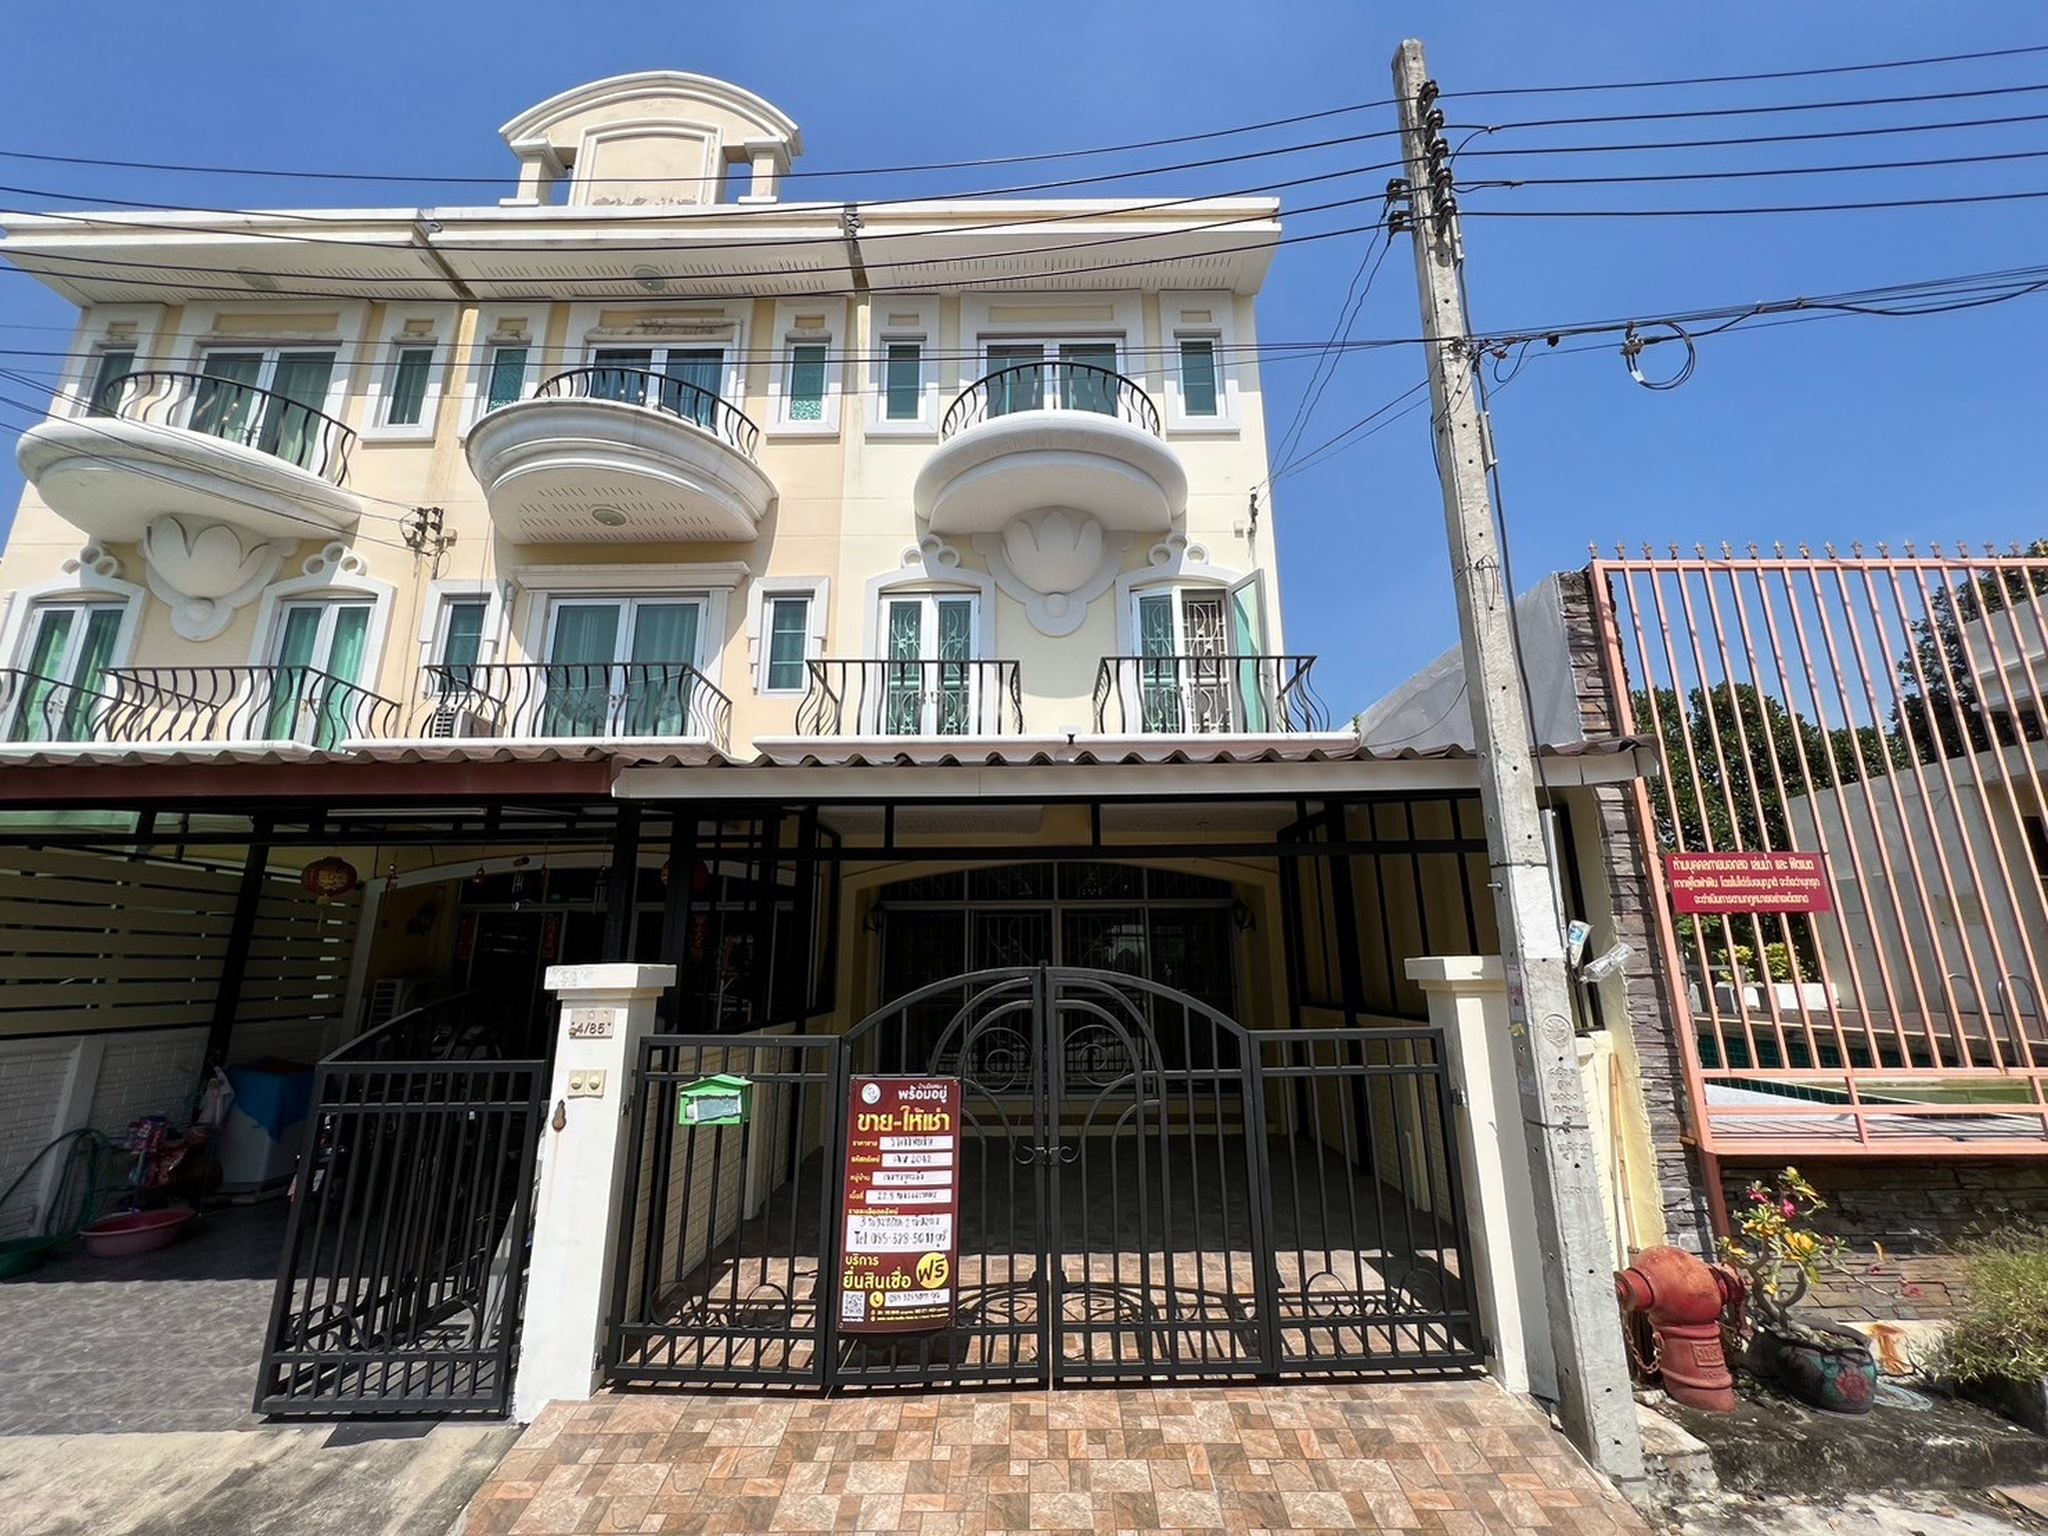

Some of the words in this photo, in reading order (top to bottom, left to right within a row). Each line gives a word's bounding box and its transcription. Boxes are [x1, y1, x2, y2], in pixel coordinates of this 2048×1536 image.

[897, 1085, 948, 1104] พร้อมอยู่
[856, 1105, 951, 1132] ขาย-ให้เช่า
[845, 1253, 880, 1266] บริการ
[918, 1258, 947, 1283] ฟรี
[842, 1266, 912, 1289] ยื่นสินเชื่อ
